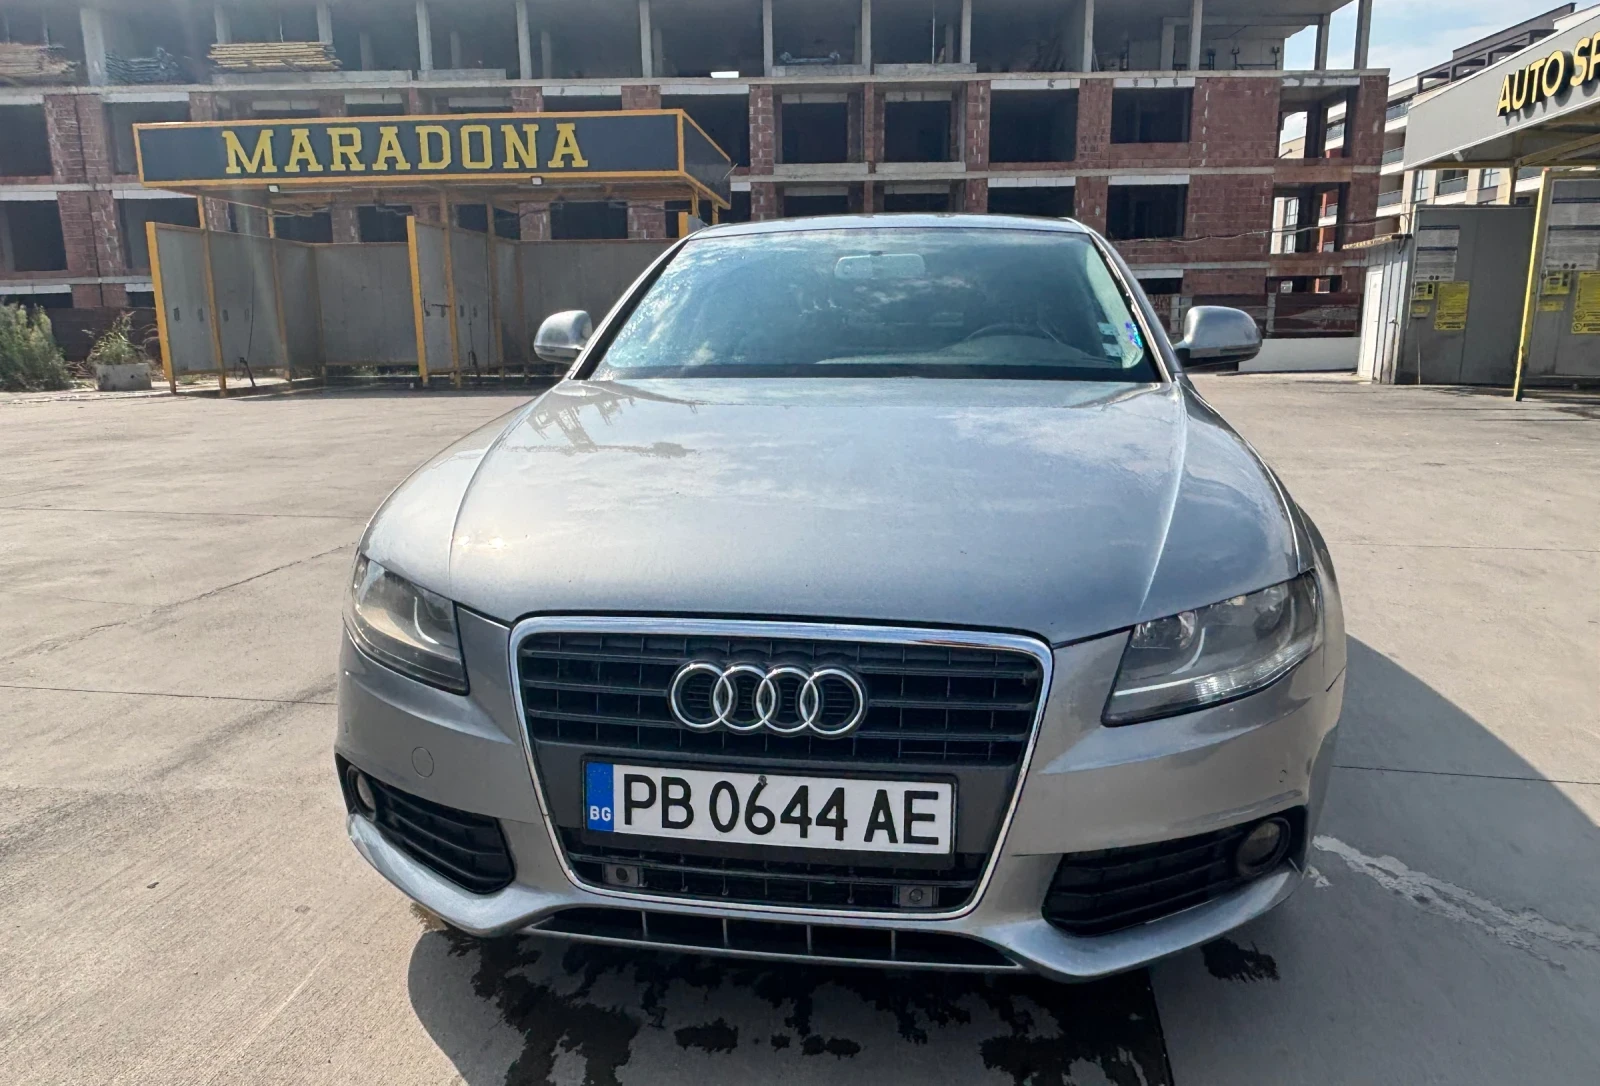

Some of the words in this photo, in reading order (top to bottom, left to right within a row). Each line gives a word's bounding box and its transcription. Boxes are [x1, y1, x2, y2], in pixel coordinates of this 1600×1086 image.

[1496, 50, 1564, 117] AUTO
[221, 123, 589, 174] MARADONA
[590, 805, 612, 822] BG
[623, 773, 695, 830] PB
[709, 778, 848, 842] 0644
[863, 789, 940, 846] AE
